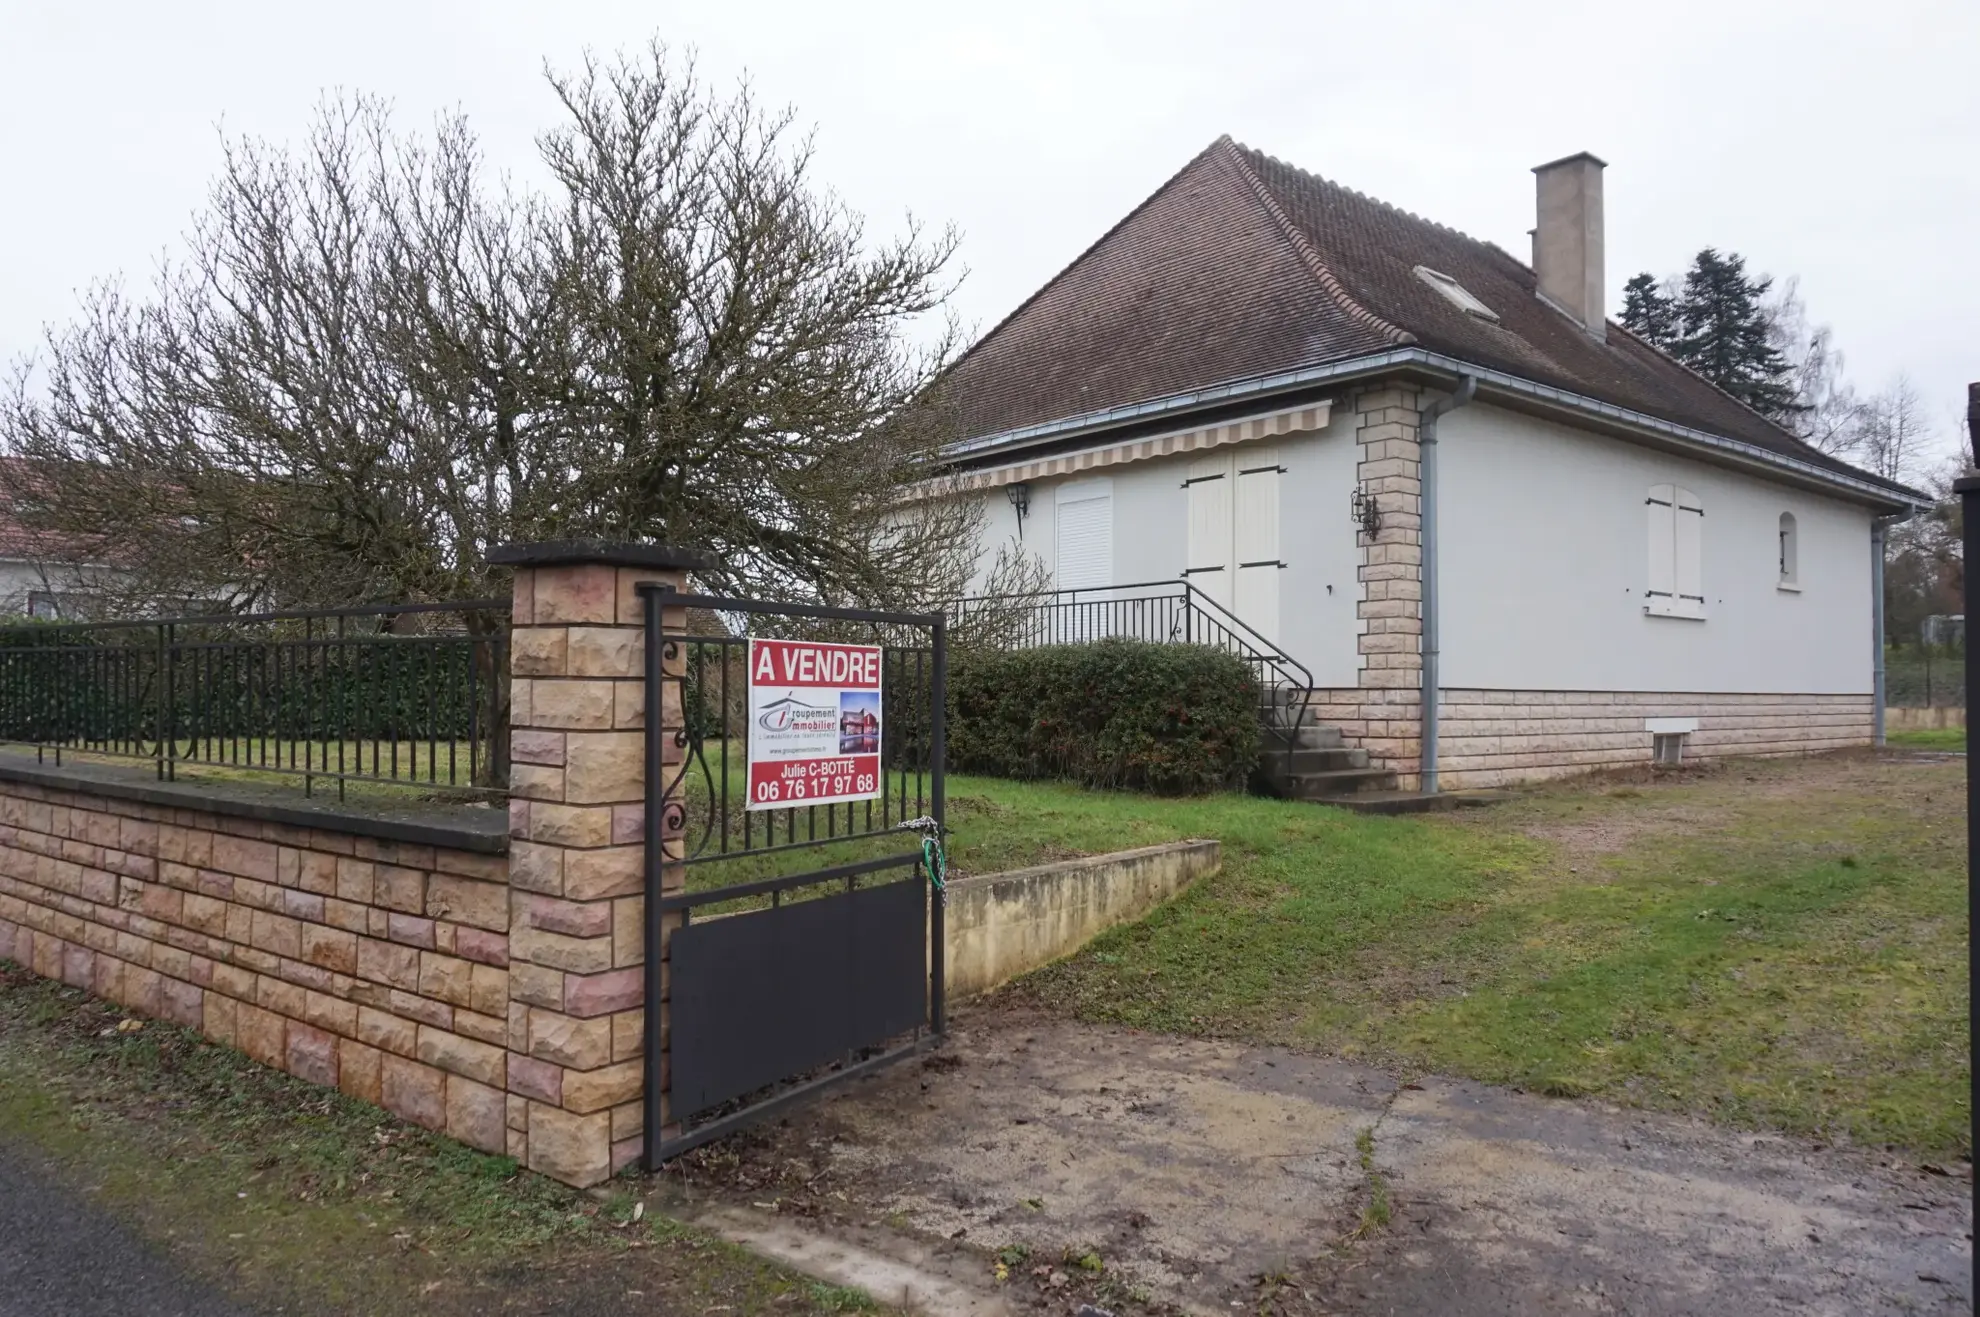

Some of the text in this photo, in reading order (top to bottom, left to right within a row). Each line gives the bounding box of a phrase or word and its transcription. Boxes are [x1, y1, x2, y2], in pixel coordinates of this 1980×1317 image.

[755, 647, 877, 684] A VENDRE
[781, 757, 855, 779] Julie C-BOTTÉ
[757, 774, 874, 802] 06 76 17 97 68
